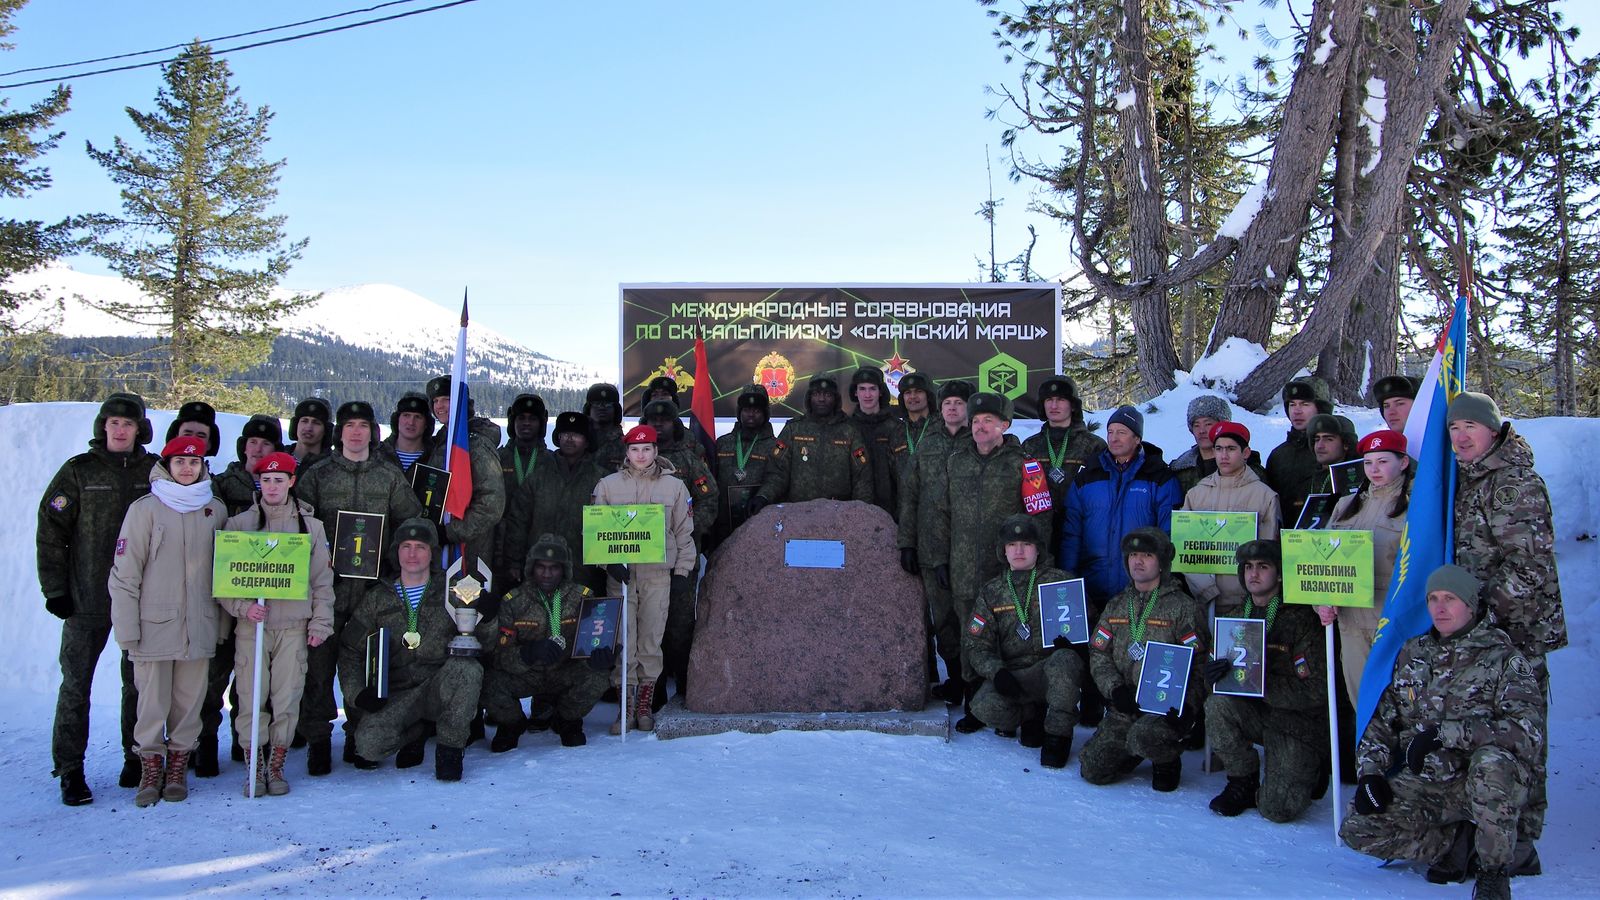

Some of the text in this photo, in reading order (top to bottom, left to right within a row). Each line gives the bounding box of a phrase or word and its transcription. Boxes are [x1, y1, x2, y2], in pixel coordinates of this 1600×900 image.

[672, 302, 1011, 320] МЕЖДУНАРОДНЫЕ СОРЕВНОВАНИЯ
[636, 319, 1049, 340] ПО СКИ-АЛЬПИНИЗМУ «САЯНСКИЙ МАРШ»
[425, 490, 432, 506] 1
[597, 531, 651, 541] РЕСПУБЛИКА
[353, 536, 362, 554] 1
[608, 544, 641, 554] АНГОЛА
[1183, 540, 1240, 551] РЕСПУБЛИКА
[229, 560, 295, 574] РОССИЙСКАЯ
[1179, 554, 1240, 565] ТАДЖИКИСТА
[1297, 564, 1357, 578] РЕСПУБЛИКА
[231, 576, 291, 589] ФЕДЕРАЦИЯ
[1300, 580, 1354, 594] КАЗАХСТАН
[1057, 605, 1070, 622] 2
[592, 620, 604, 636] 3
[1233, 647, 1247, 667] 2
[1157, 669, 1172, 688] 2
